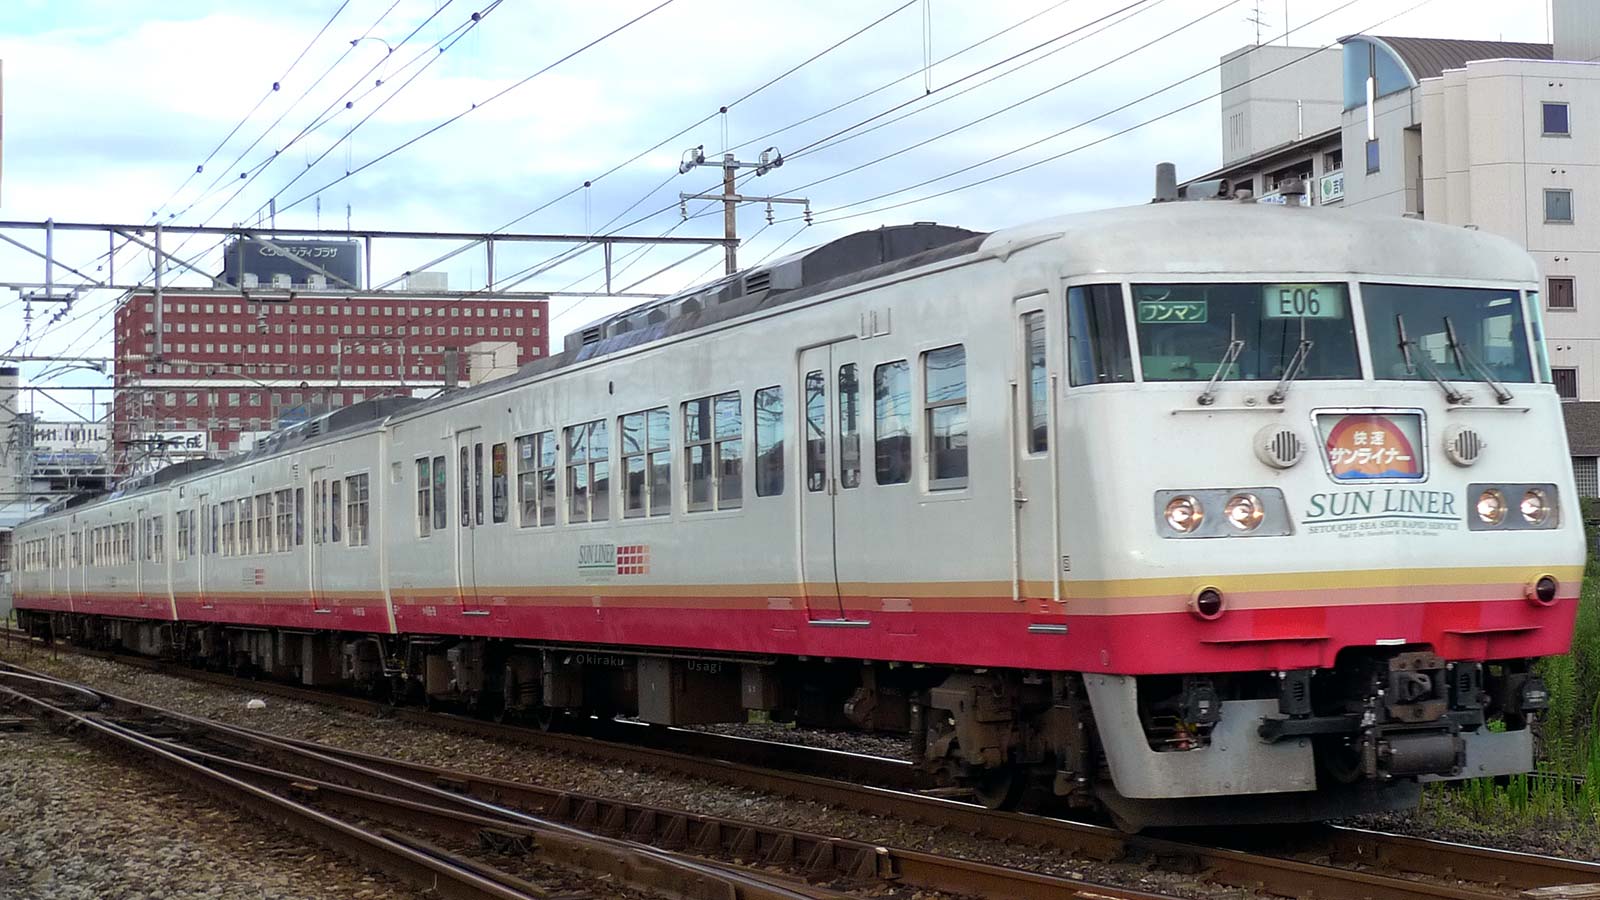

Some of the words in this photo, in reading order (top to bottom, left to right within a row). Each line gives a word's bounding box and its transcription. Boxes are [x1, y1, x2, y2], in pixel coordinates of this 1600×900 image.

[1279, 288, 1321, 316] E06
[1142, 304, 1205, 321] ワンマン
[1353, 430, 1386, 446] 快速
[1329, 447, 1411, 465] サンライナー
[1305, 490, 1376, 518] SUN
[1382, 488, 1457, 515] LINER
